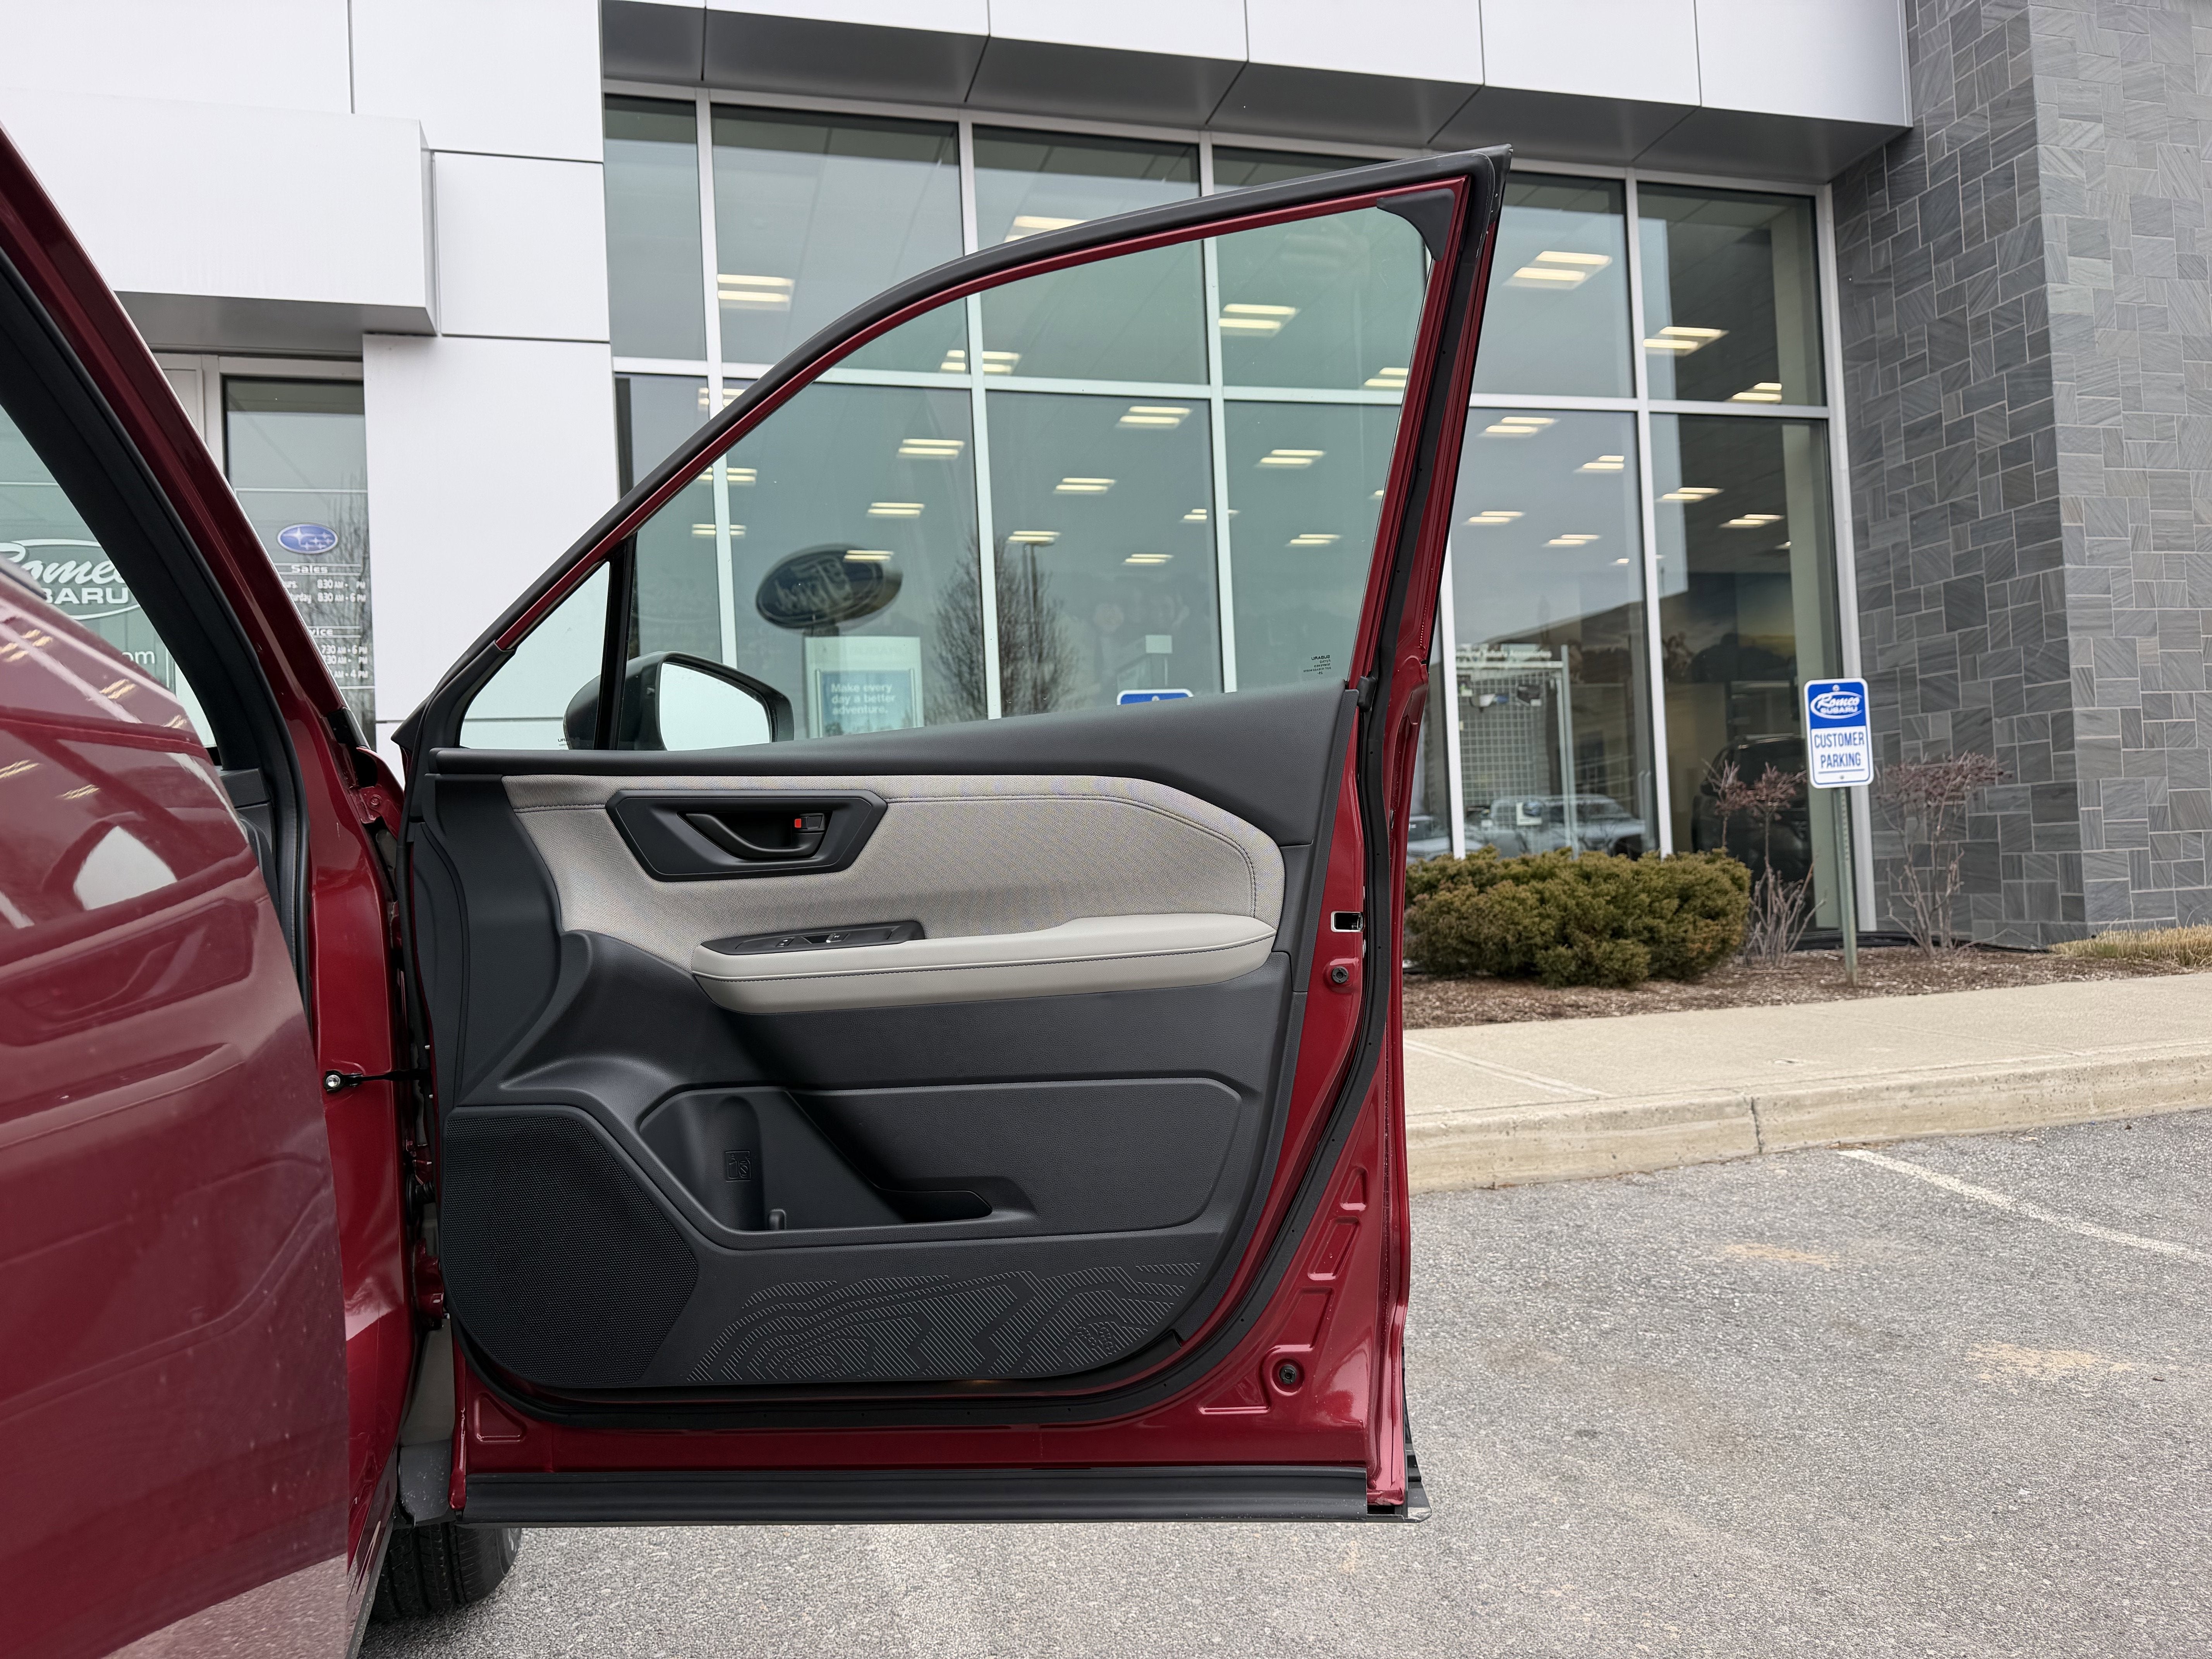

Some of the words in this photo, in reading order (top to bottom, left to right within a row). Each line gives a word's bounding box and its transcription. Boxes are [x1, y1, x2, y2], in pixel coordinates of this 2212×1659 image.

[291, 564, 328, 574] Sales
[350, 593, 356, 602] 6
[352, 645, 357, 654] 6
[350, 669, 356, 678] 4
[831, 684, 860, 692] Make
[863, 684, 892, 694] every
[831, 695, 851, 705] day
[863, 694, 895, 703] better
[1817, 696, 1860, 709] Romeo
[1814, 732, 1865, 749] CUSTOMER
[1820, 752, 1861, 768] PARKING
